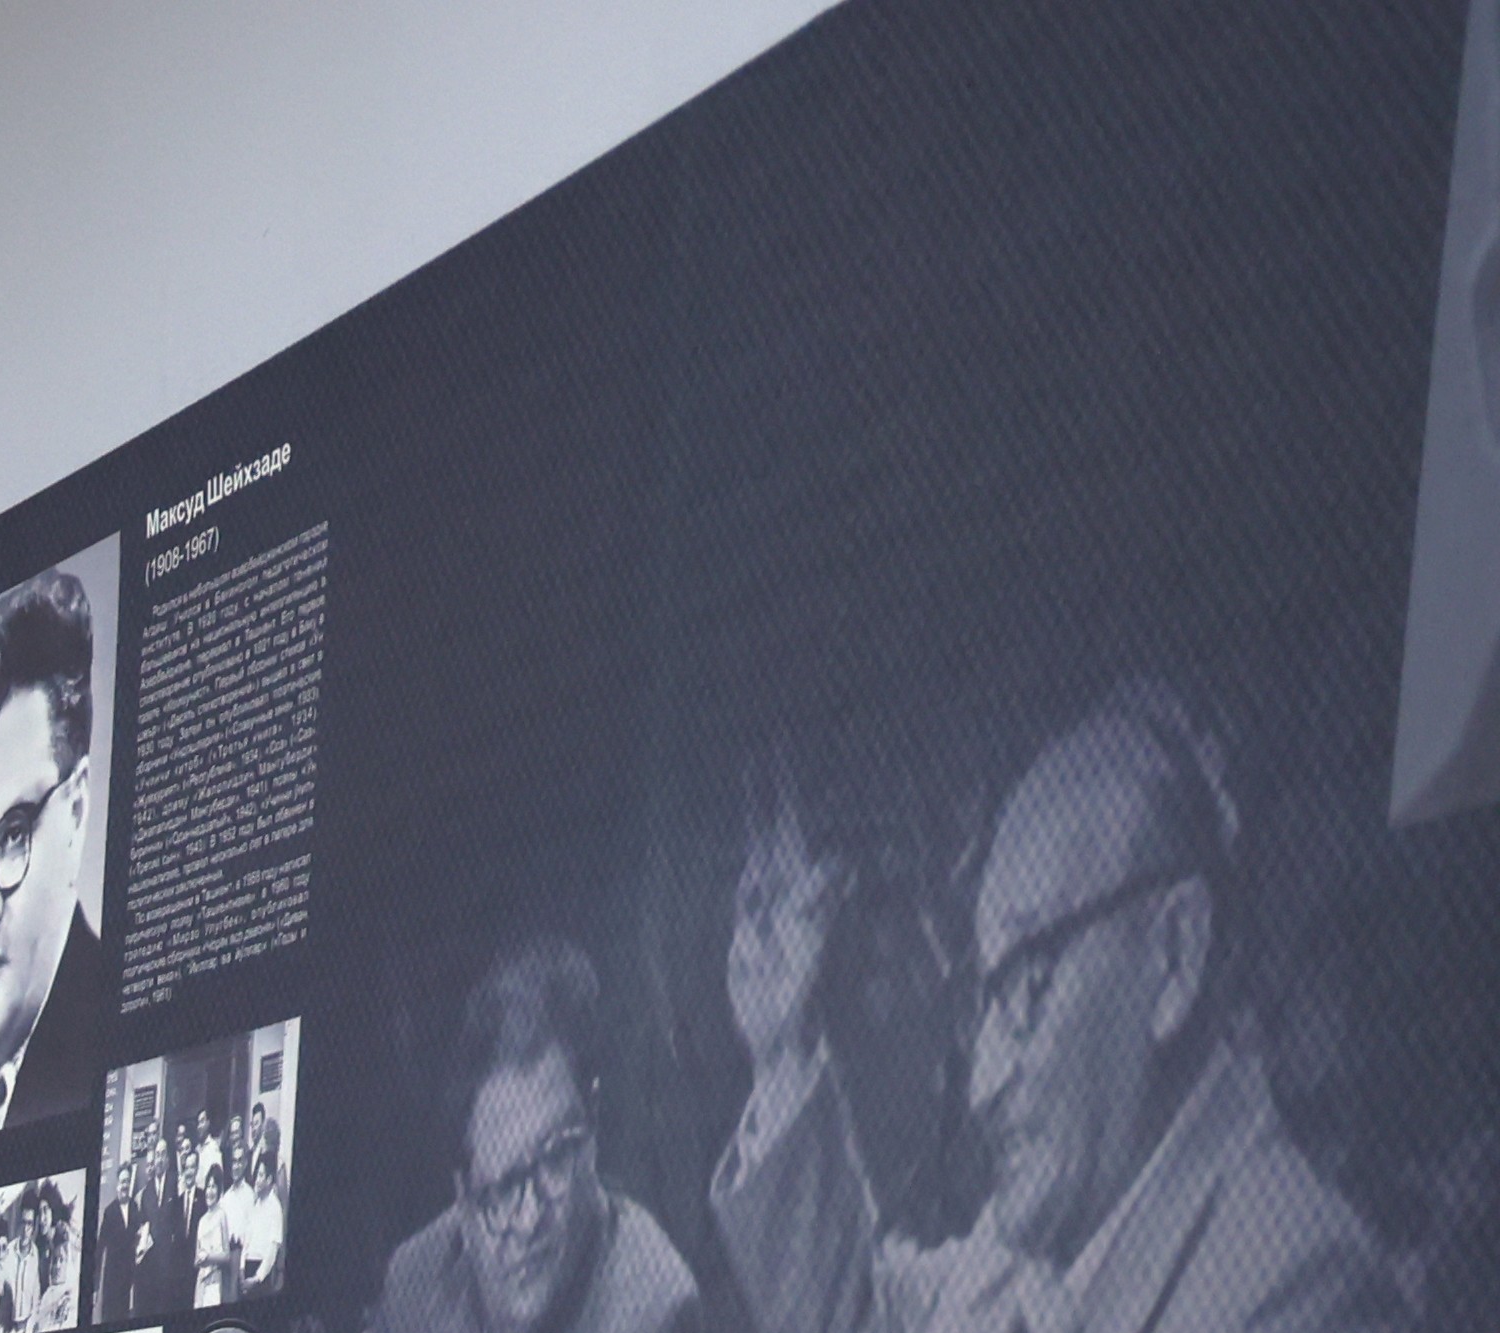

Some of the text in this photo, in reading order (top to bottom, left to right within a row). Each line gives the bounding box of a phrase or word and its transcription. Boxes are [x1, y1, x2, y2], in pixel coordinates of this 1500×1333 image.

[146, 440, 293, 539] Максуд Шейхзаде
[144, 526, 220, 588] (1908-1967)
